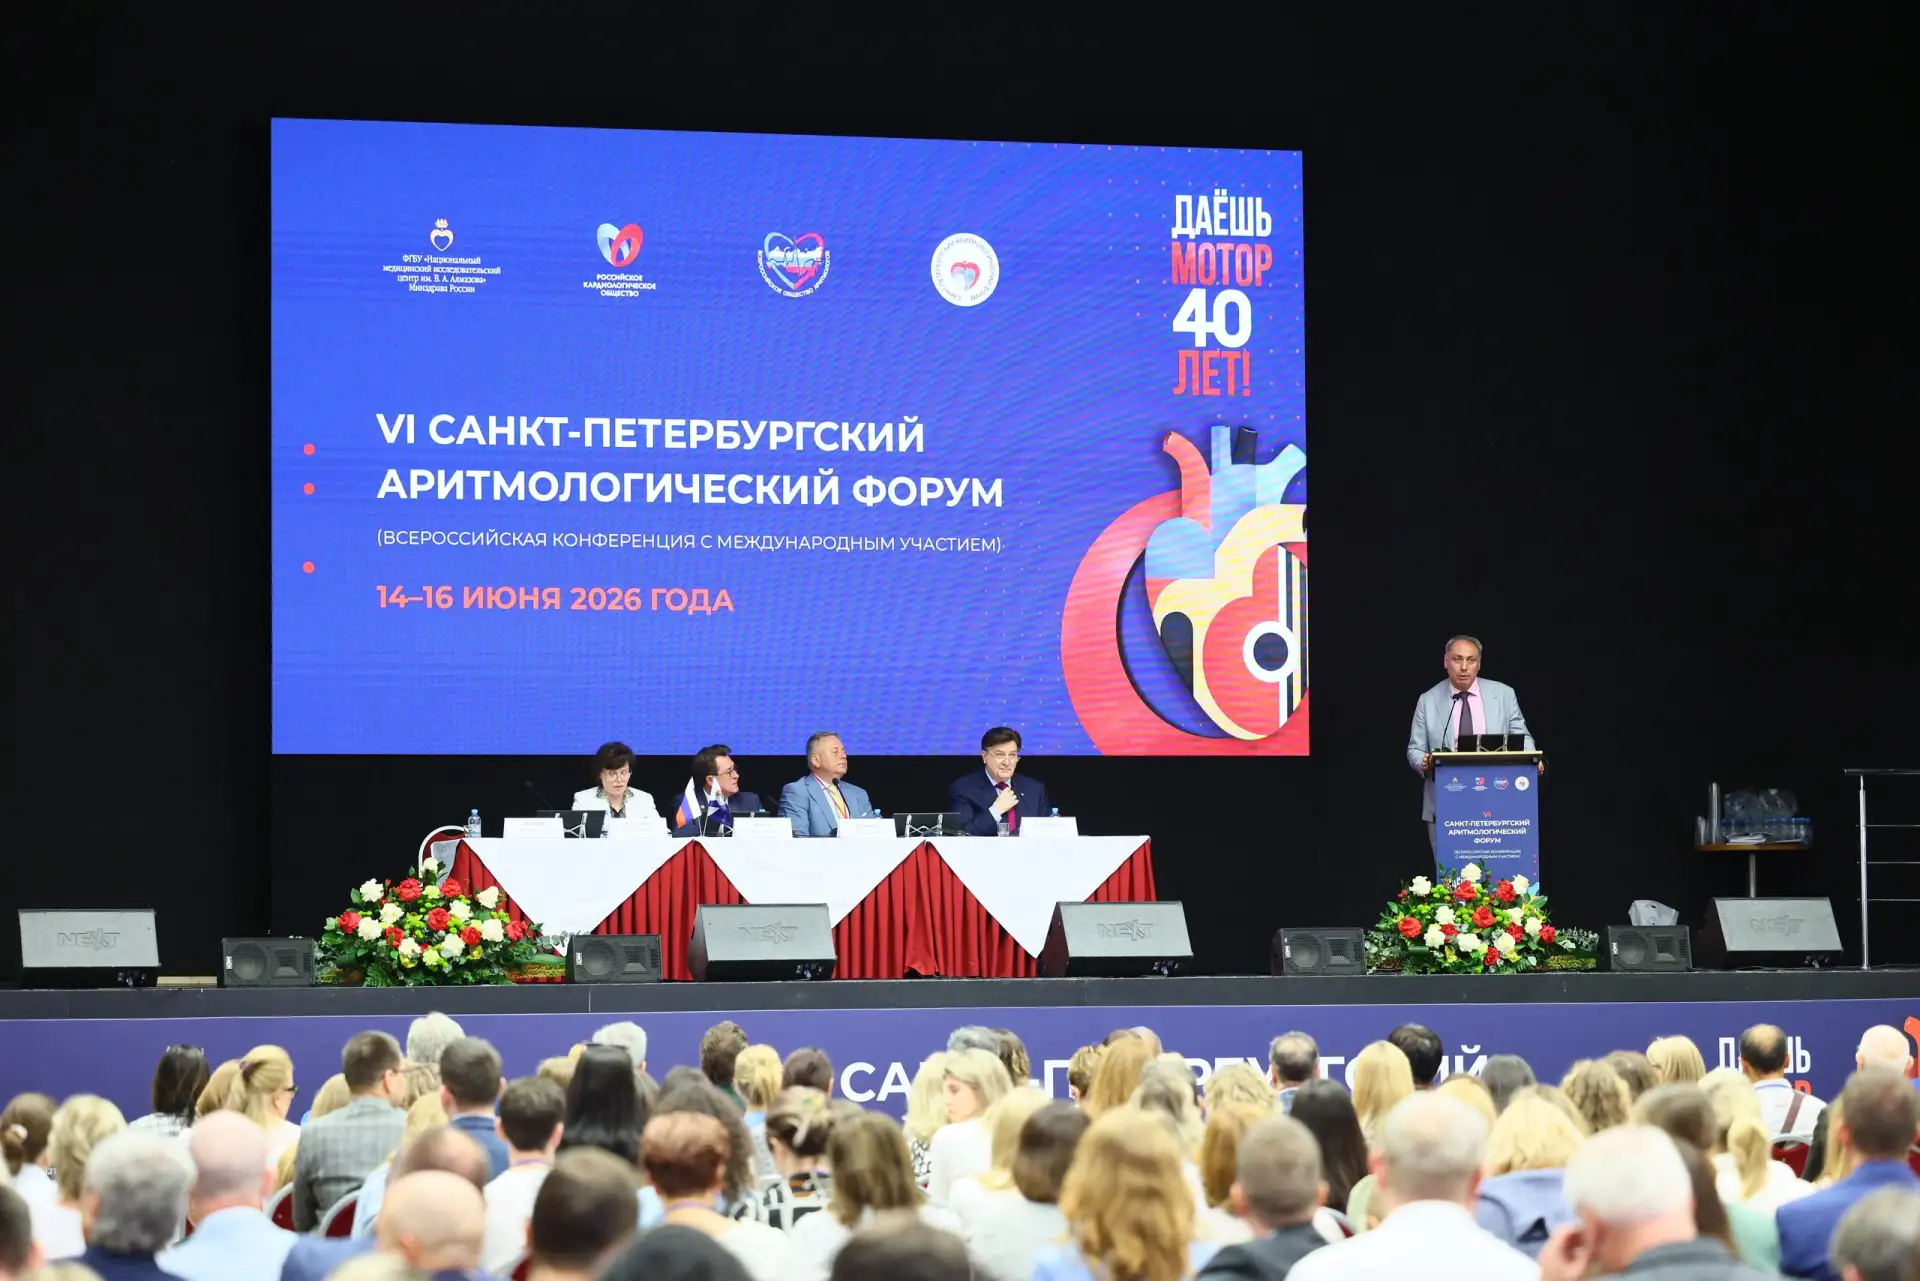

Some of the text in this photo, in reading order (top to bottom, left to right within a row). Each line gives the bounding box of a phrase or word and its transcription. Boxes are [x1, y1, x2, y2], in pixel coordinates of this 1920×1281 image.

[1171, 188, 1272, 239] ДАЁШЬ
[1171, 241, 1273, 287] МОТОР
[583, 281, 657, 290] КАРДИОЛОГИЧЕСКОЕ
[596, 273, 643, 281] РОССИЙСКОЕ
[449, 285, 476, 293] России
[600, 290, 639, 298] ОБЩЕСТВО
[1172, 288, 1252, 348] 40
[1173, 349, 1250, 397] ЛЕТ!
[375, 413, 924, 452] VI САНКТ-ПЕТЕРБУРГСКИЙ
[377, 467, 1004, 507] АРИТМОЛОГИЧЕСКИЙ ФОРУМ
[377, 528, 1002, 554] (ВСЕРОССИЙСКАЯ КОНФЕРЕНЦИЯ С МЕЖДУНАРОДНЫМ УЧАСТИЕМ)
[463, 585, 561, 609] ИЮНЯ
[570, 587, 642, 611] 2026
[651, 588, 735, 616] ГОДА
[1444, 819, 1530, 827] САНКТ-ПЕТЕРБУРГСКИЙ
[1448, 828, 1527, 836] АРИТМОЛОГИЧЕСКИЙ
[57, 927, 120, 950] NEXT
[738, 922, 797, 943] NEXT
[1097, 919, 1153, 941] NEXT
